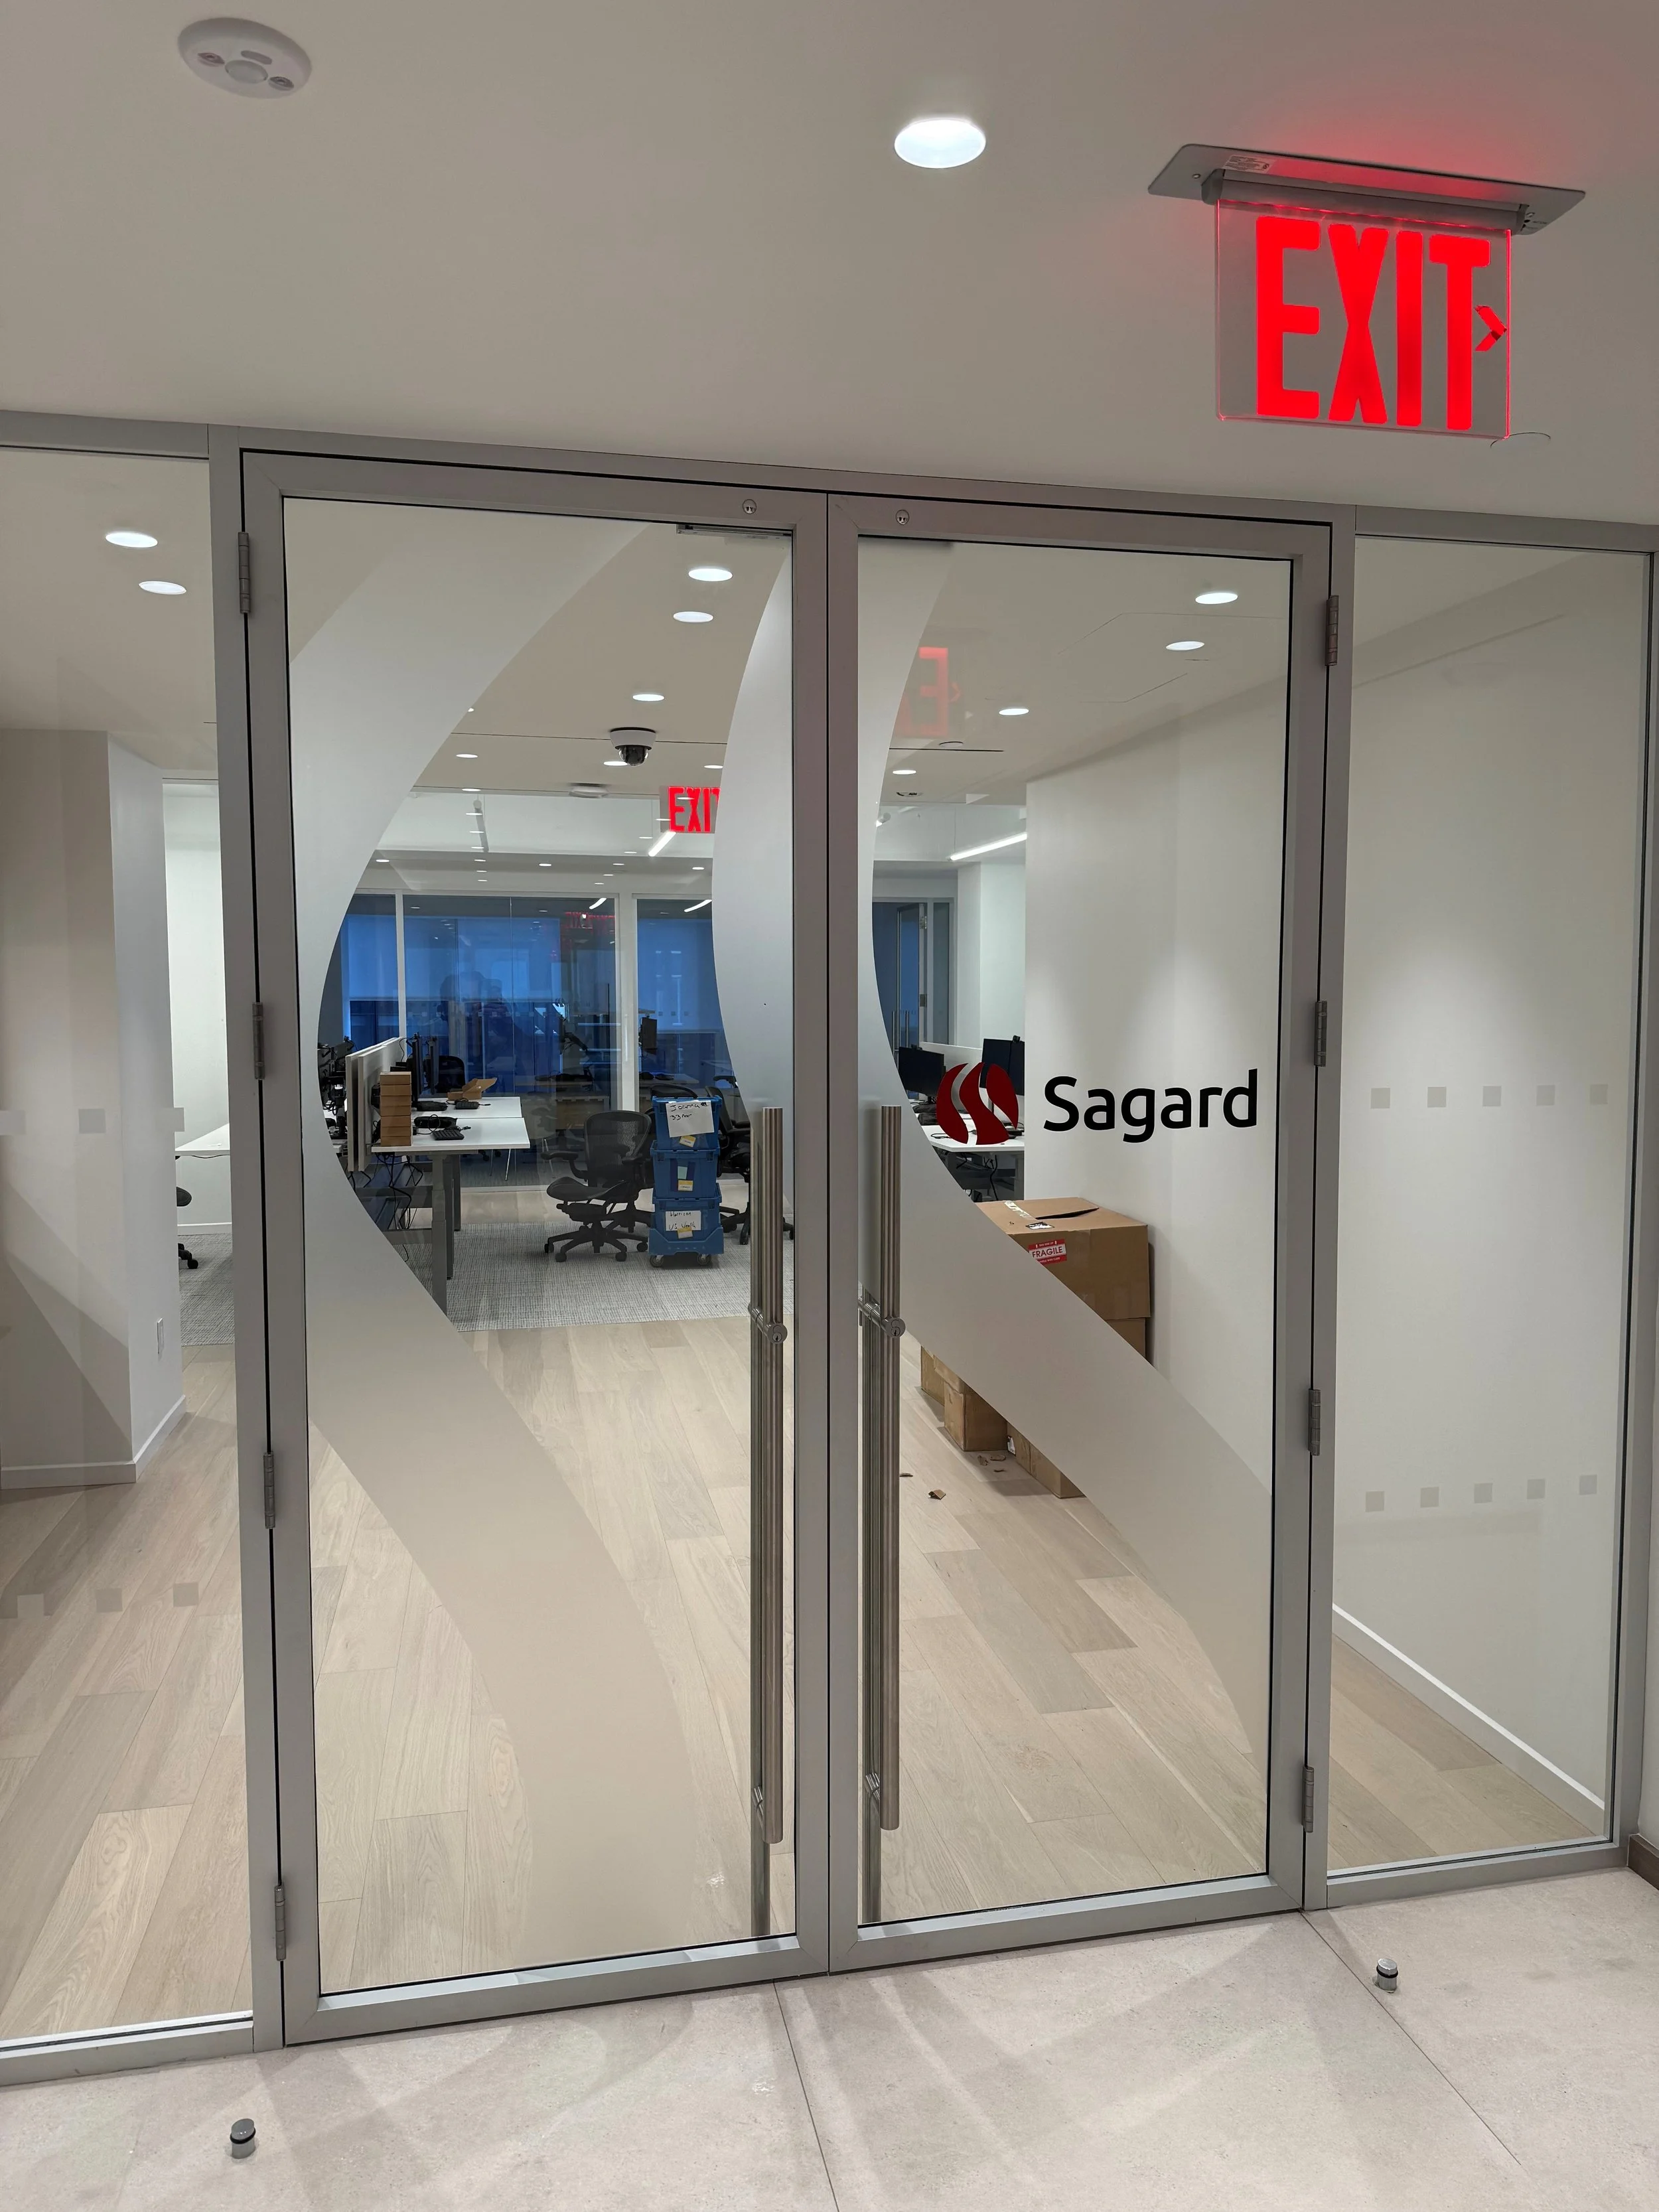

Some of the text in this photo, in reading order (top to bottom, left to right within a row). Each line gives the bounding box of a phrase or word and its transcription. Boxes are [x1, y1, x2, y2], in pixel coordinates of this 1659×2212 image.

[1256, 215, 1490, 430] EXIT
[1043, 1068, 1258, 1143] Sagard
[1032, 1246, 1063, 1258] FRAGILE
